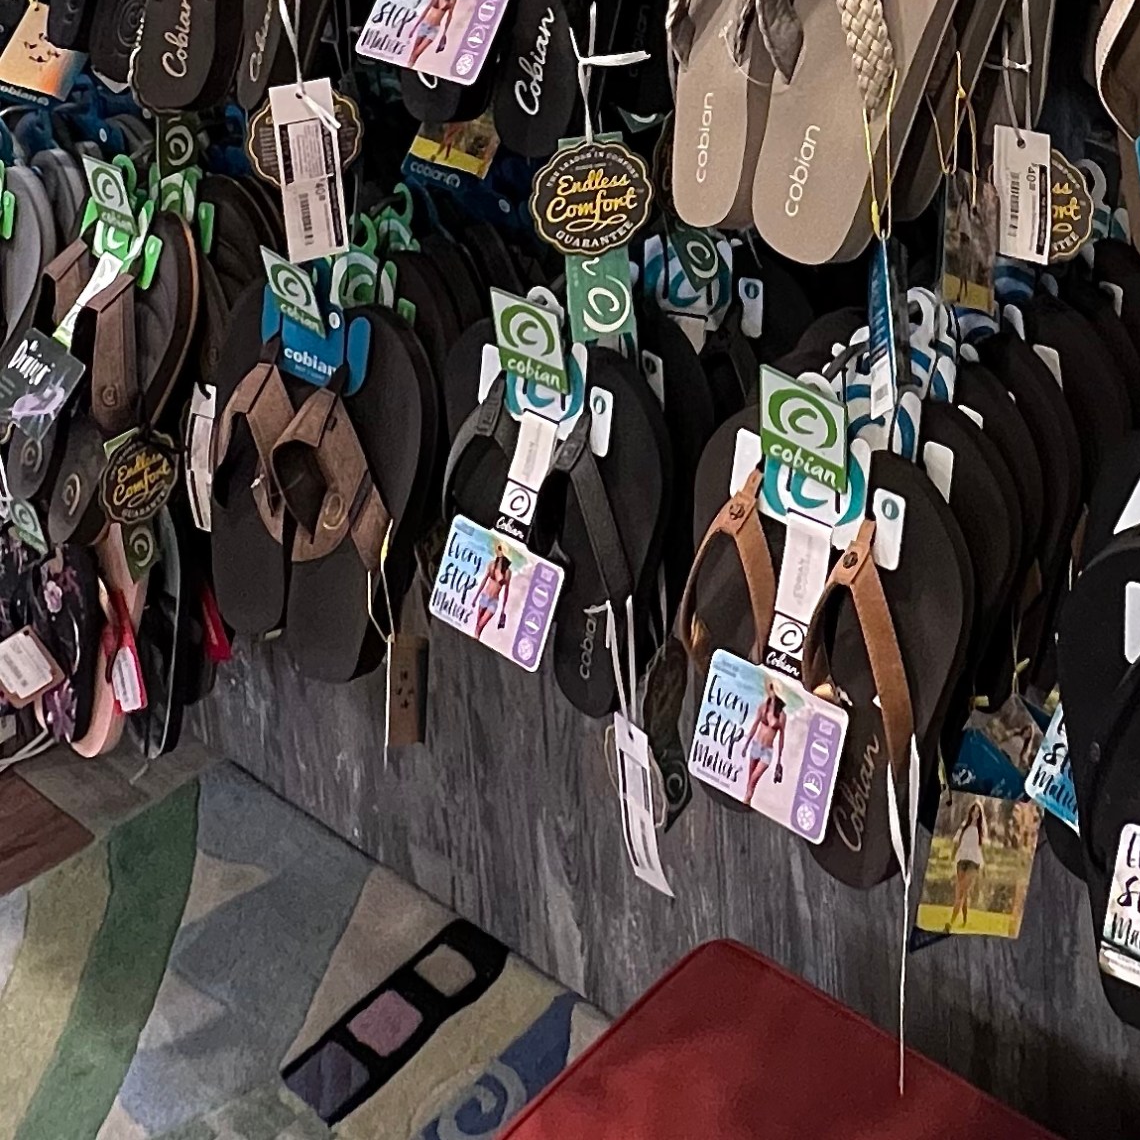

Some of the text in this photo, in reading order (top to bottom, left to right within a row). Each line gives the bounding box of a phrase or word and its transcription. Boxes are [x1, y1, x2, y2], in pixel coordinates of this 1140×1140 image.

[371, 4, 417, 40] Step
[514, 7, 556, 116] Cobian
[0, 84, 38, 104] obian
[698, 91, 714, 183] cobian
[556, 169, 632, 197] Endless
[785, 123, 821, 217] cobian
[546, 190, 638, 226] Comfort
[555, 220, 635, 248] GUARANTEE
[507, 357, 561, 386] cobian
[113, 461, 171, 505] Comfort
[117, 451, 163, 484] Endless
[769, 441, 839, 485] cobian
[447, 532, 484, 575] Every
[439, 562, 477, 605] Step
[707, 674, 750, 725] Every
[698, 712, 745, 759] Step
[832, 733, 880, 852] Cobian
